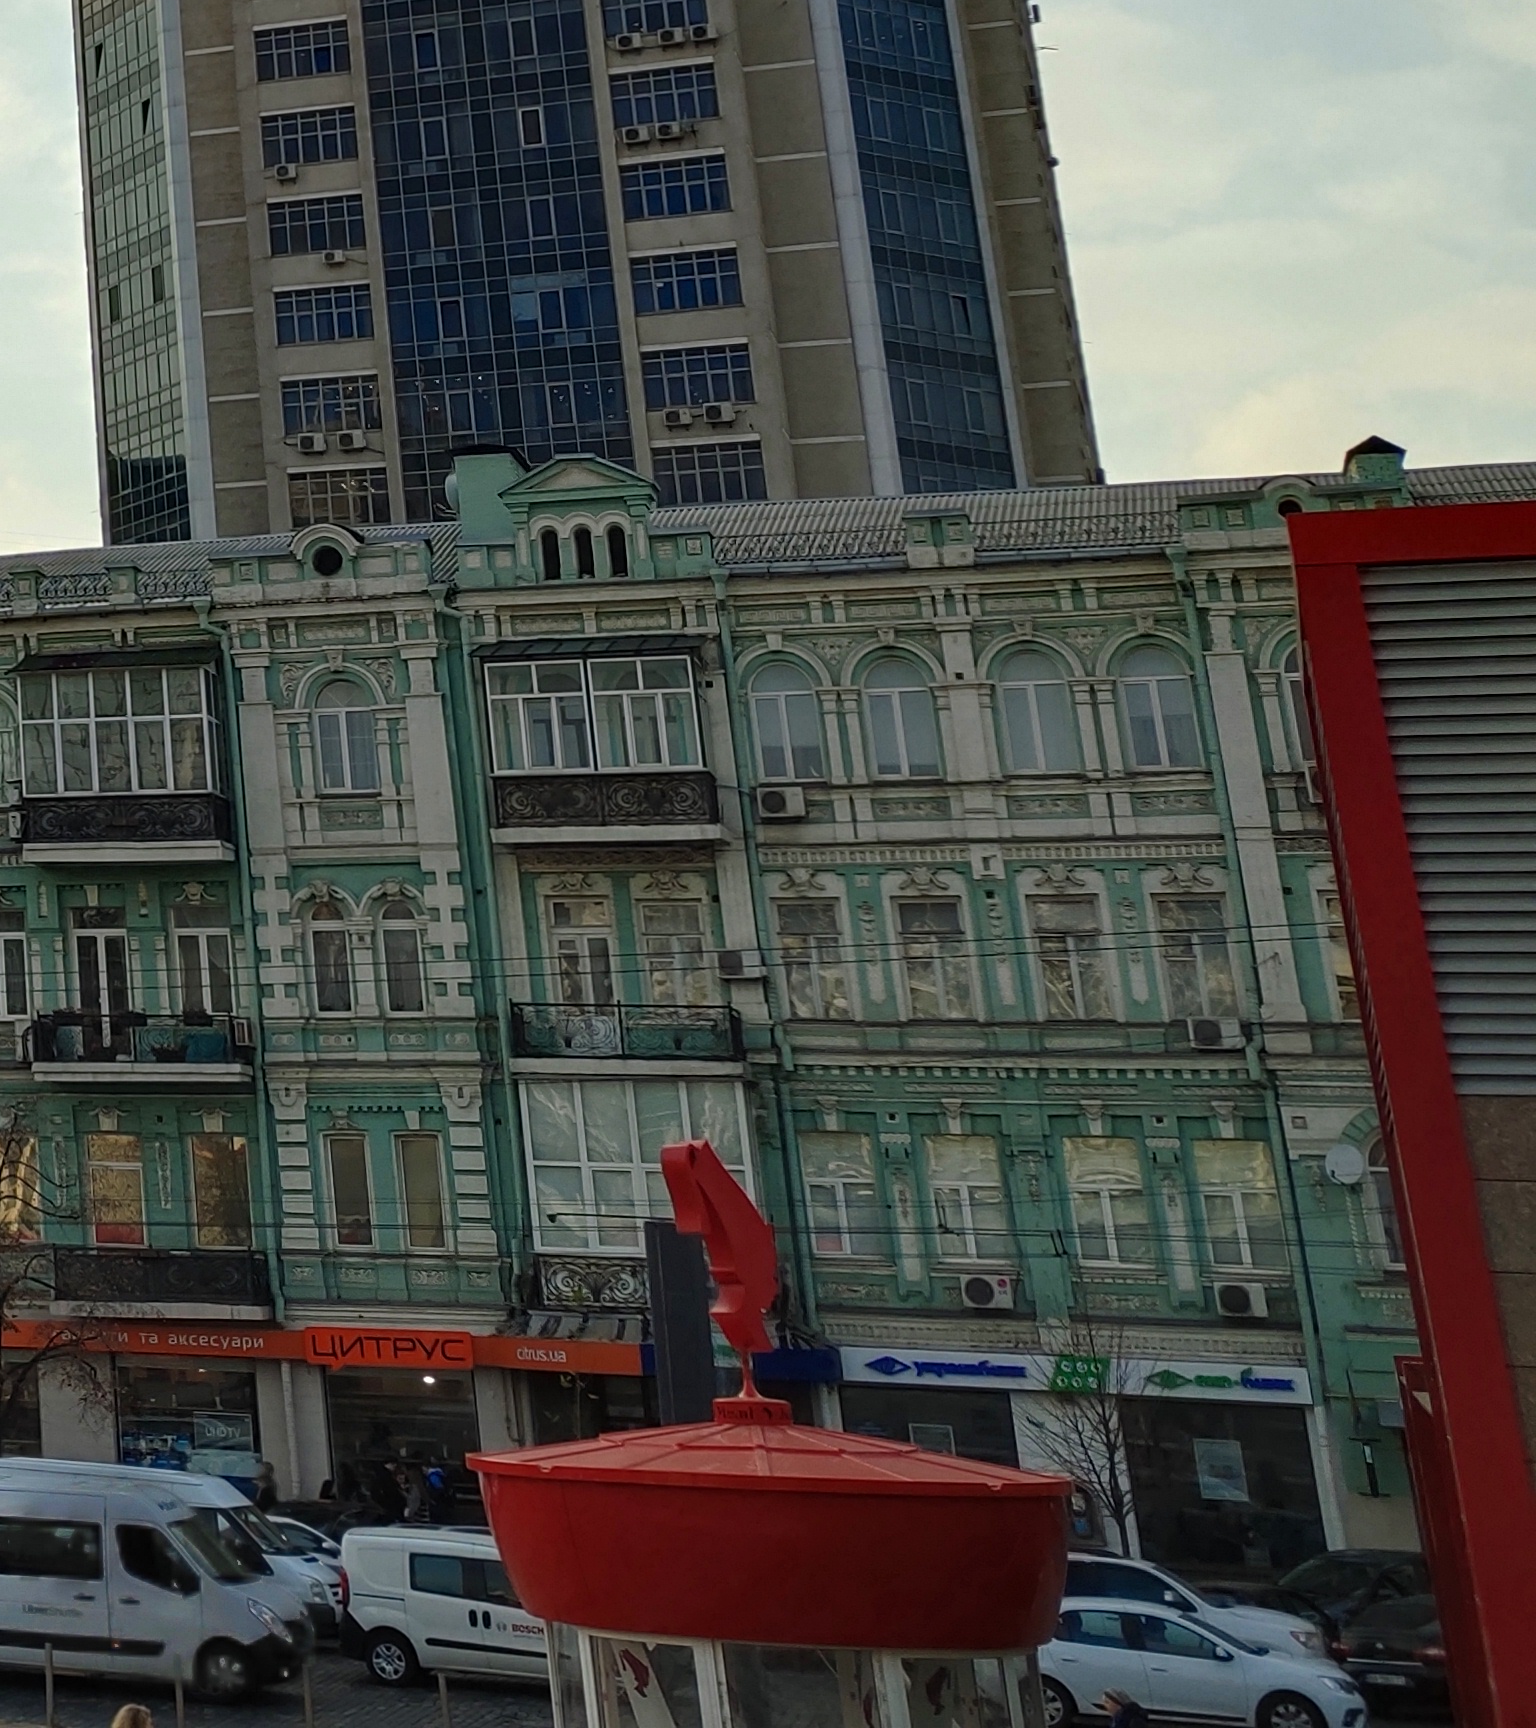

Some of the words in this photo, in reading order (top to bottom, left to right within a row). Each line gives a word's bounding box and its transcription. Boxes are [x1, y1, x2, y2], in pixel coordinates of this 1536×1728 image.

[139, 1332, 159, 1345] та
[168, 1335, 265, 1351] аксесуари
[311, 1334, 466, 1361] ЦИТРУС
[516, 1346, 567, 1363] citrus.ua
[511, 1623, 544, 1635] BOSCH
